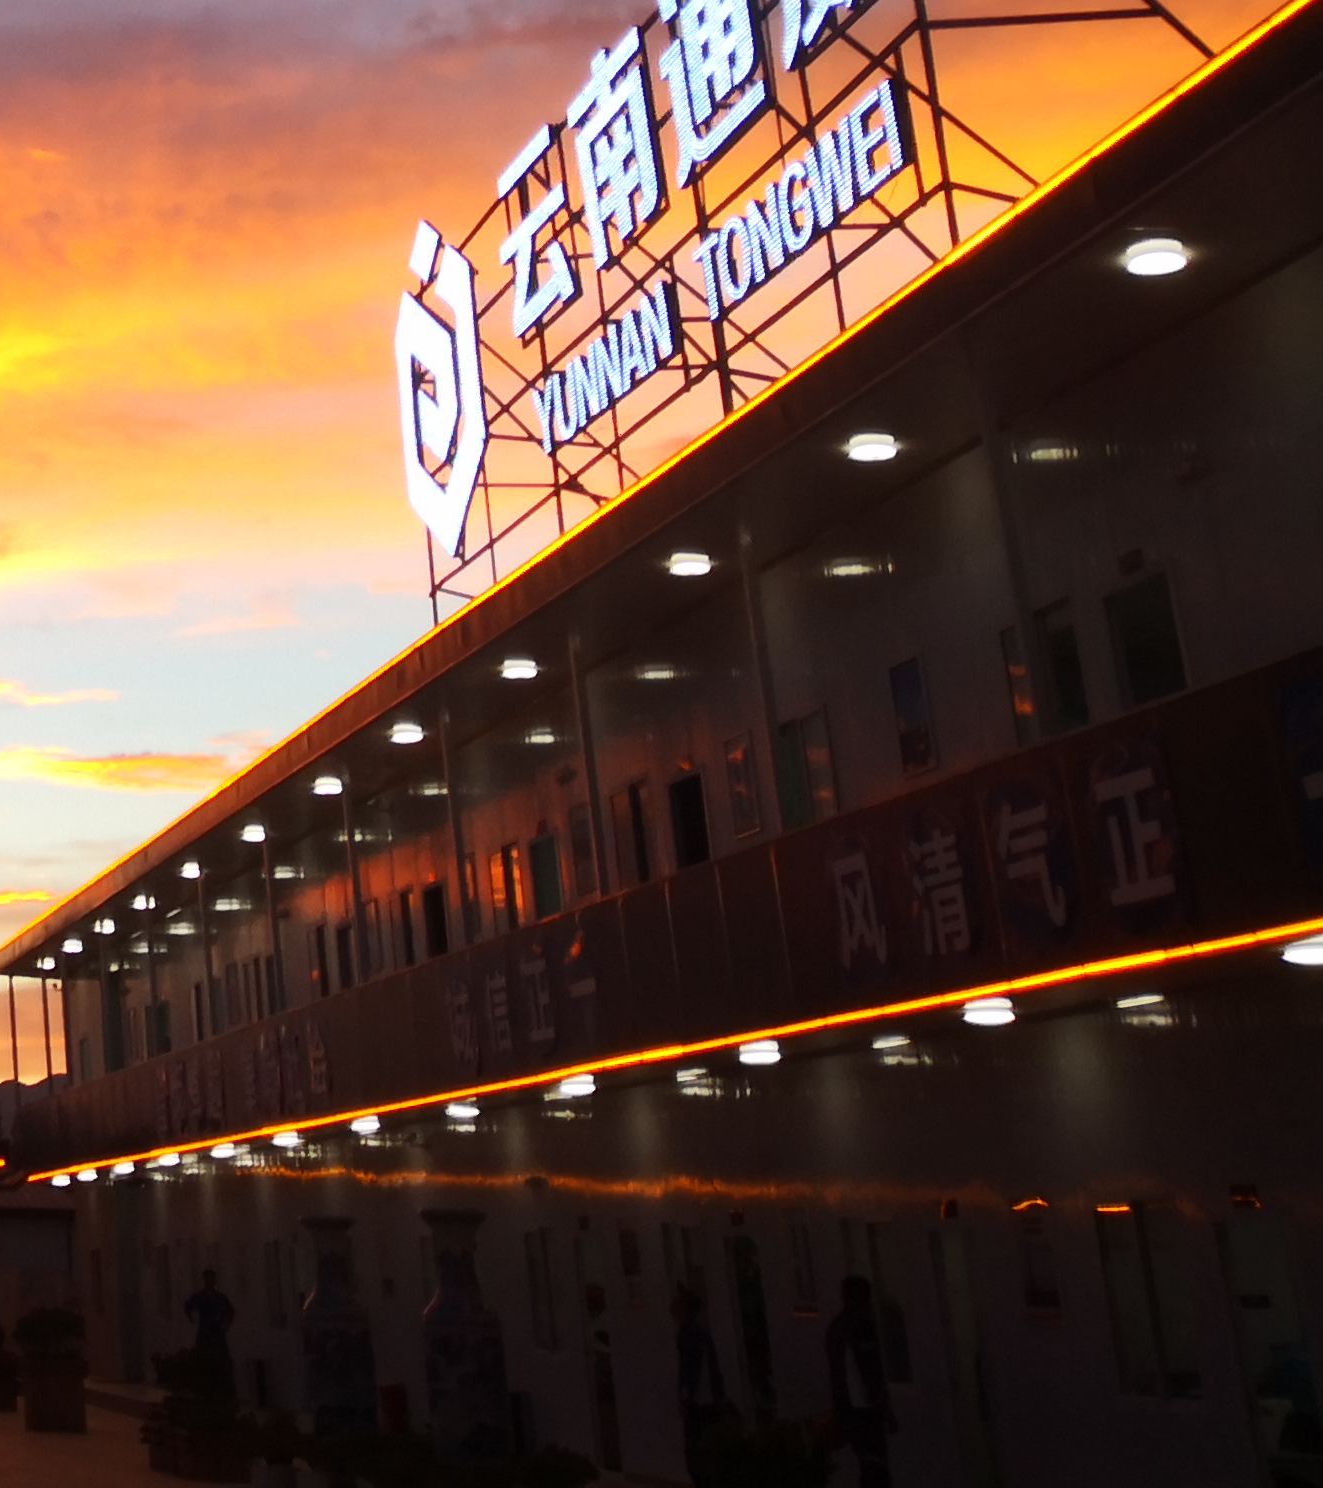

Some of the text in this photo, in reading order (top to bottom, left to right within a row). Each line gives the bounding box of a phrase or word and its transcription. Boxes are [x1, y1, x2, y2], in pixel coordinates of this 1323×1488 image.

[531, 79, 905, 454] YUNNAN TONGWEI
[832, 767, 1176, 969] 风清气正
